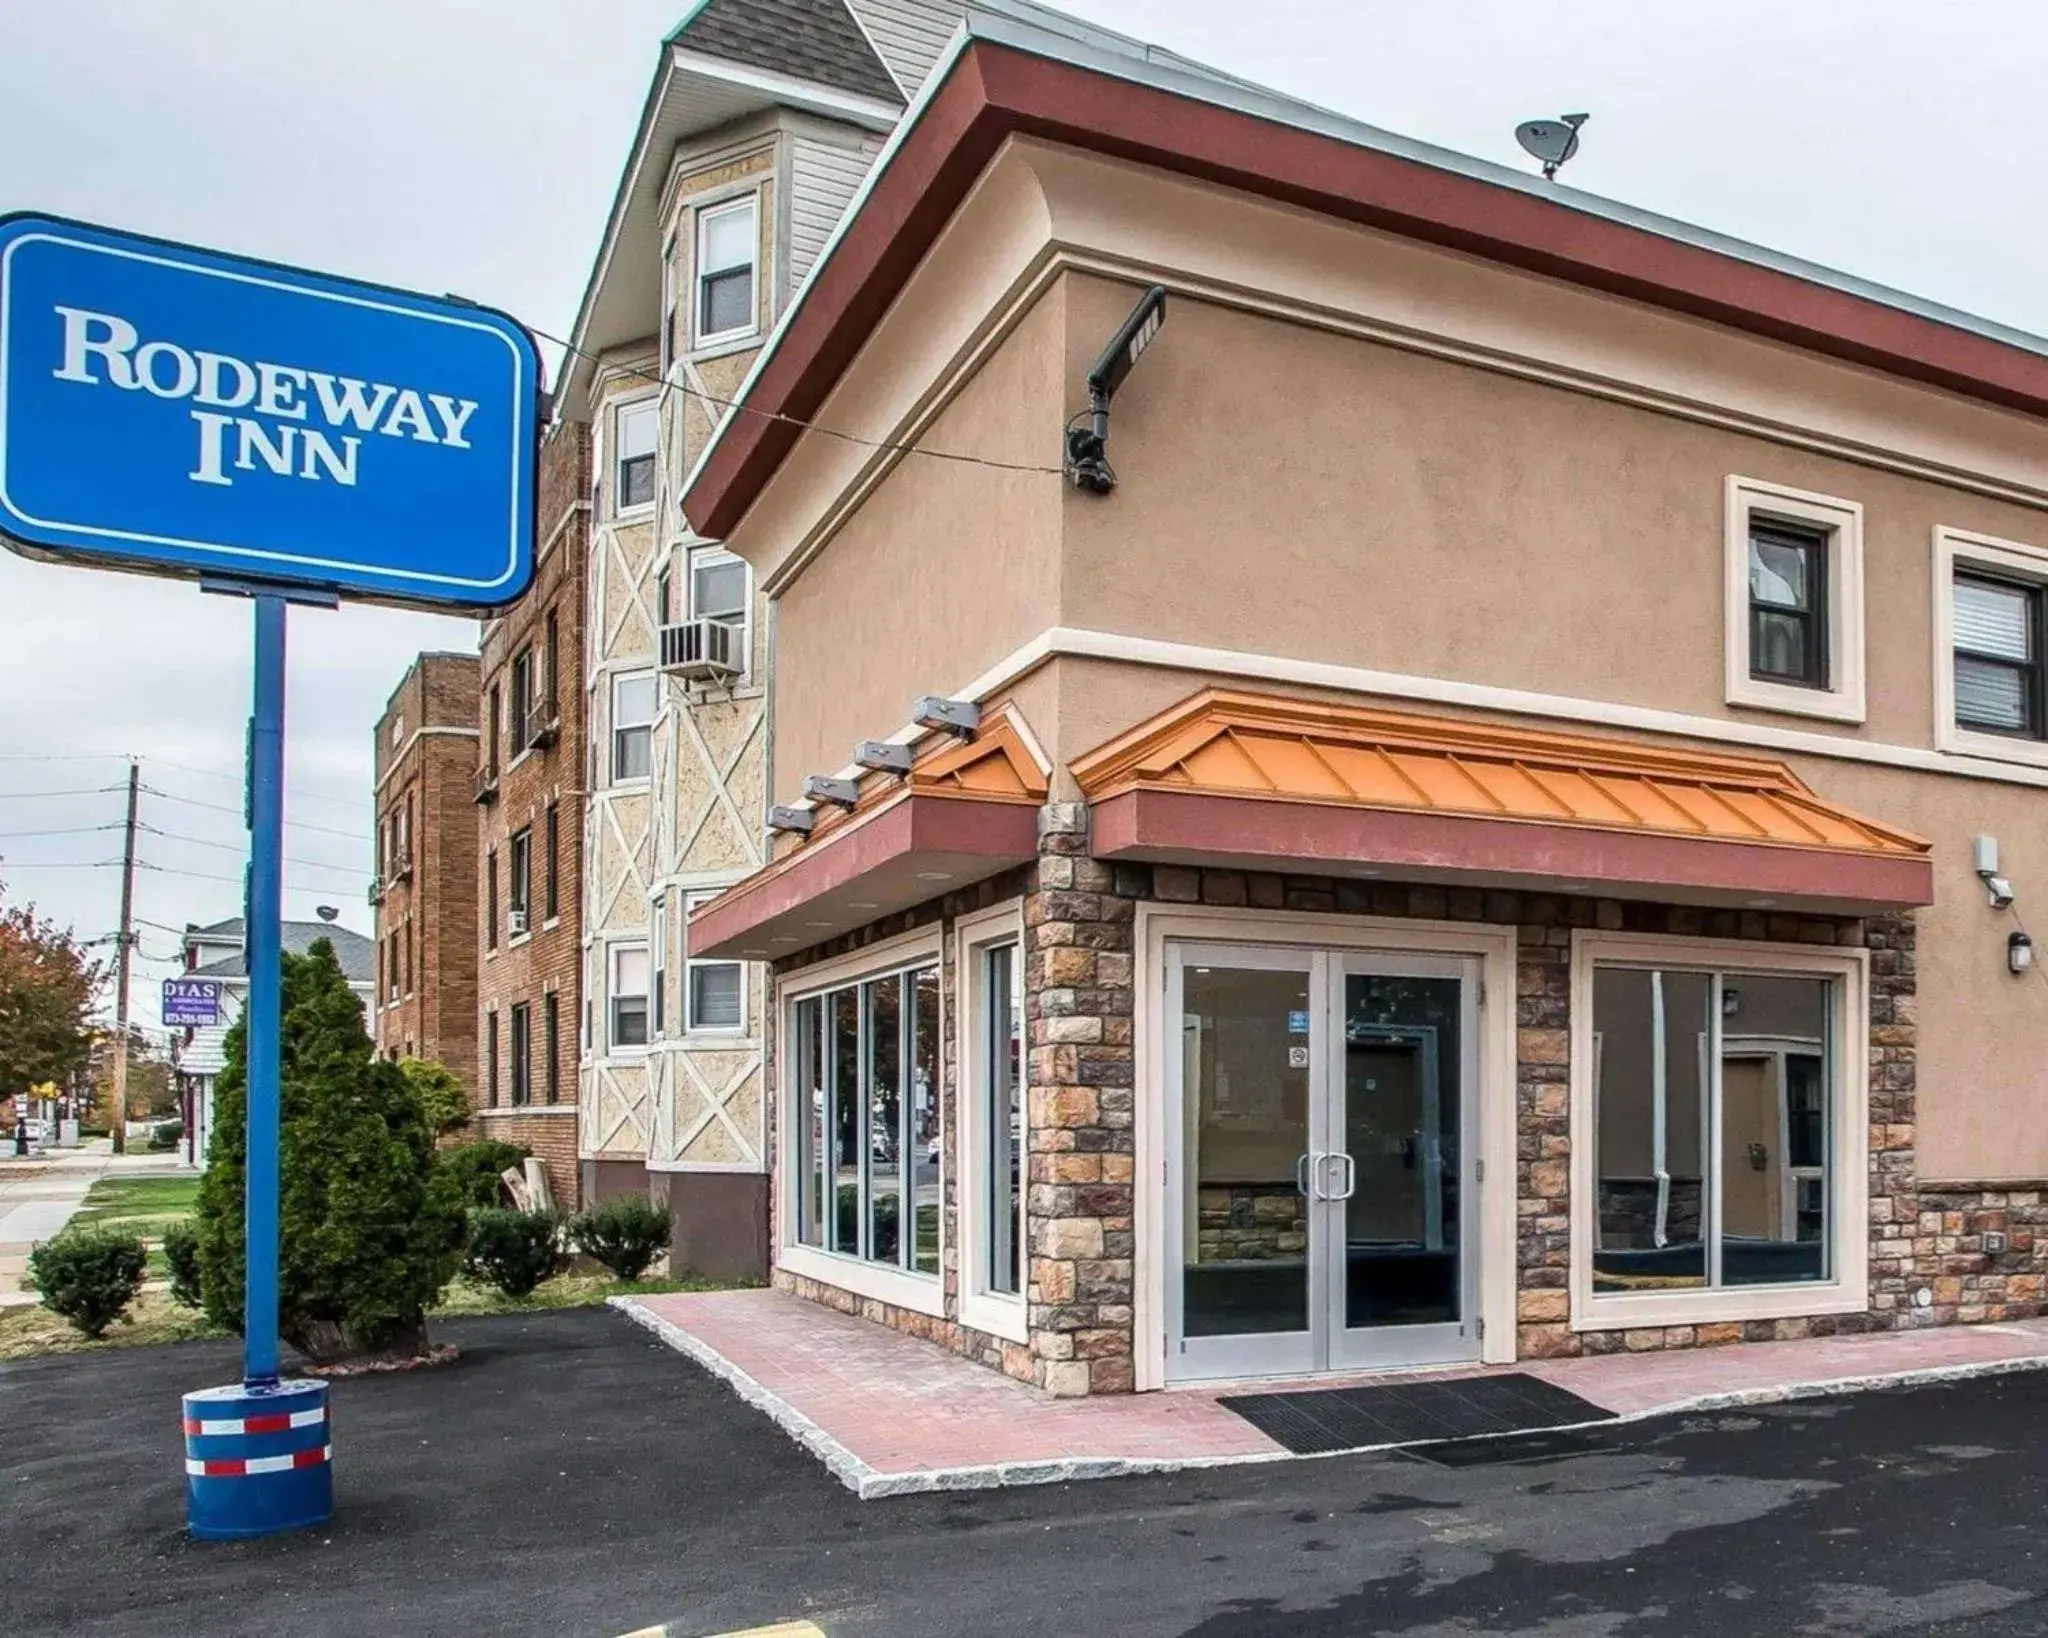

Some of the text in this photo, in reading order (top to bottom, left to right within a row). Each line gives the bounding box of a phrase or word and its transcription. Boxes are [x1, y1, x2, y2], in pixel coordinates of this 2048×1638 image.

[53, 305, 479, 449] RODEWAY
[189, 409, 362, 486] INN
[164, 982, 215, 997] DIAS
